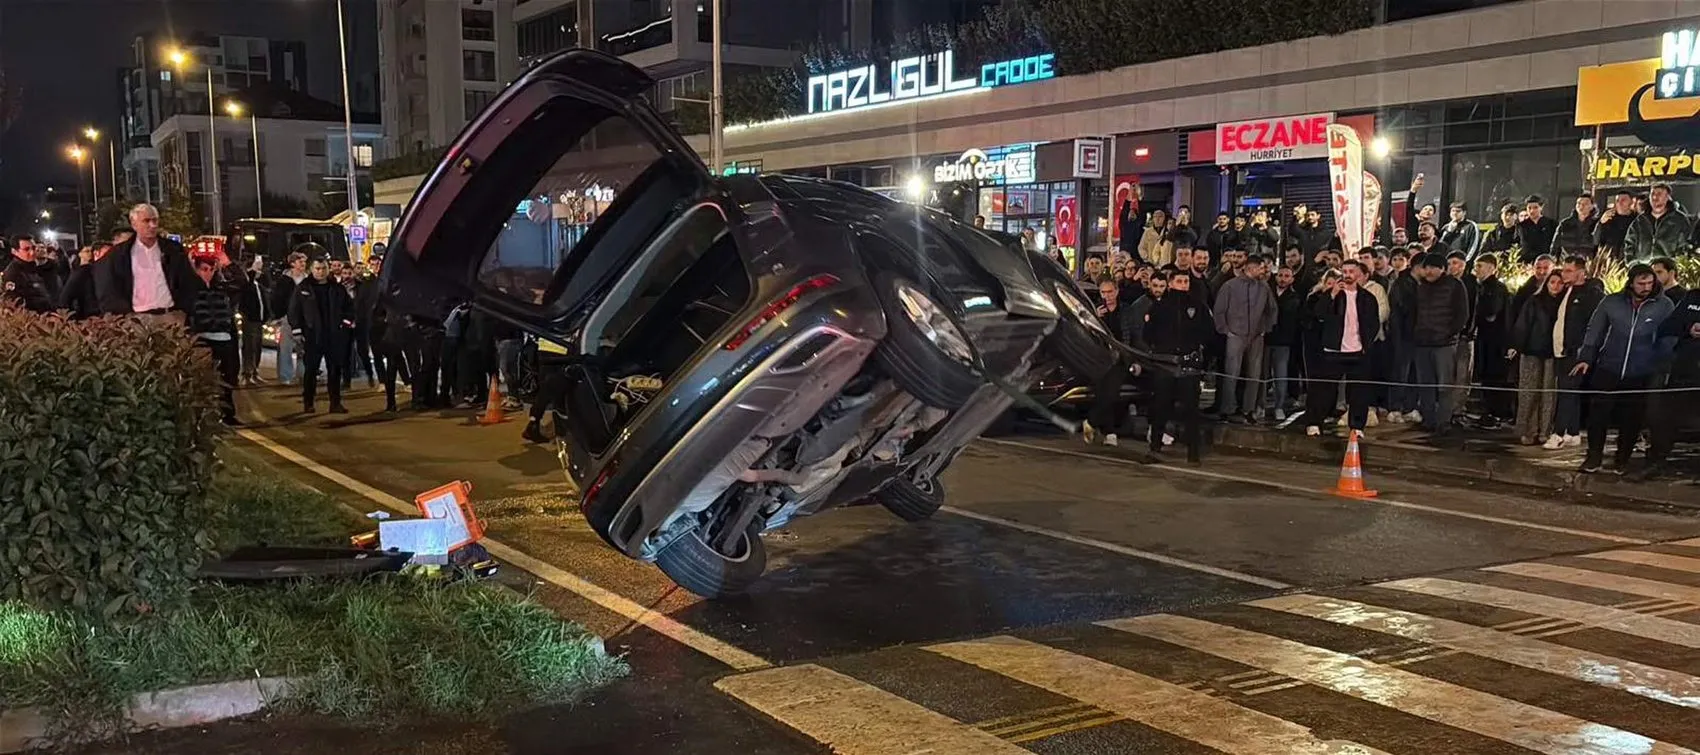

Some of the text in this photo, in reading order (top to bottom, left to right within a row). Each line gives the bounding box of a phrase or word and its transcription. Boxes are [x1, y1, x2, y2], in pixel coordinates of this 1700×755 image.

[1661, 29, 1700, 70] H
[981, 53, 1055, 89] CADDE
[1223, 117, 1327, 151] ECZANE
[934, 159, 974, 183] BİZİM
